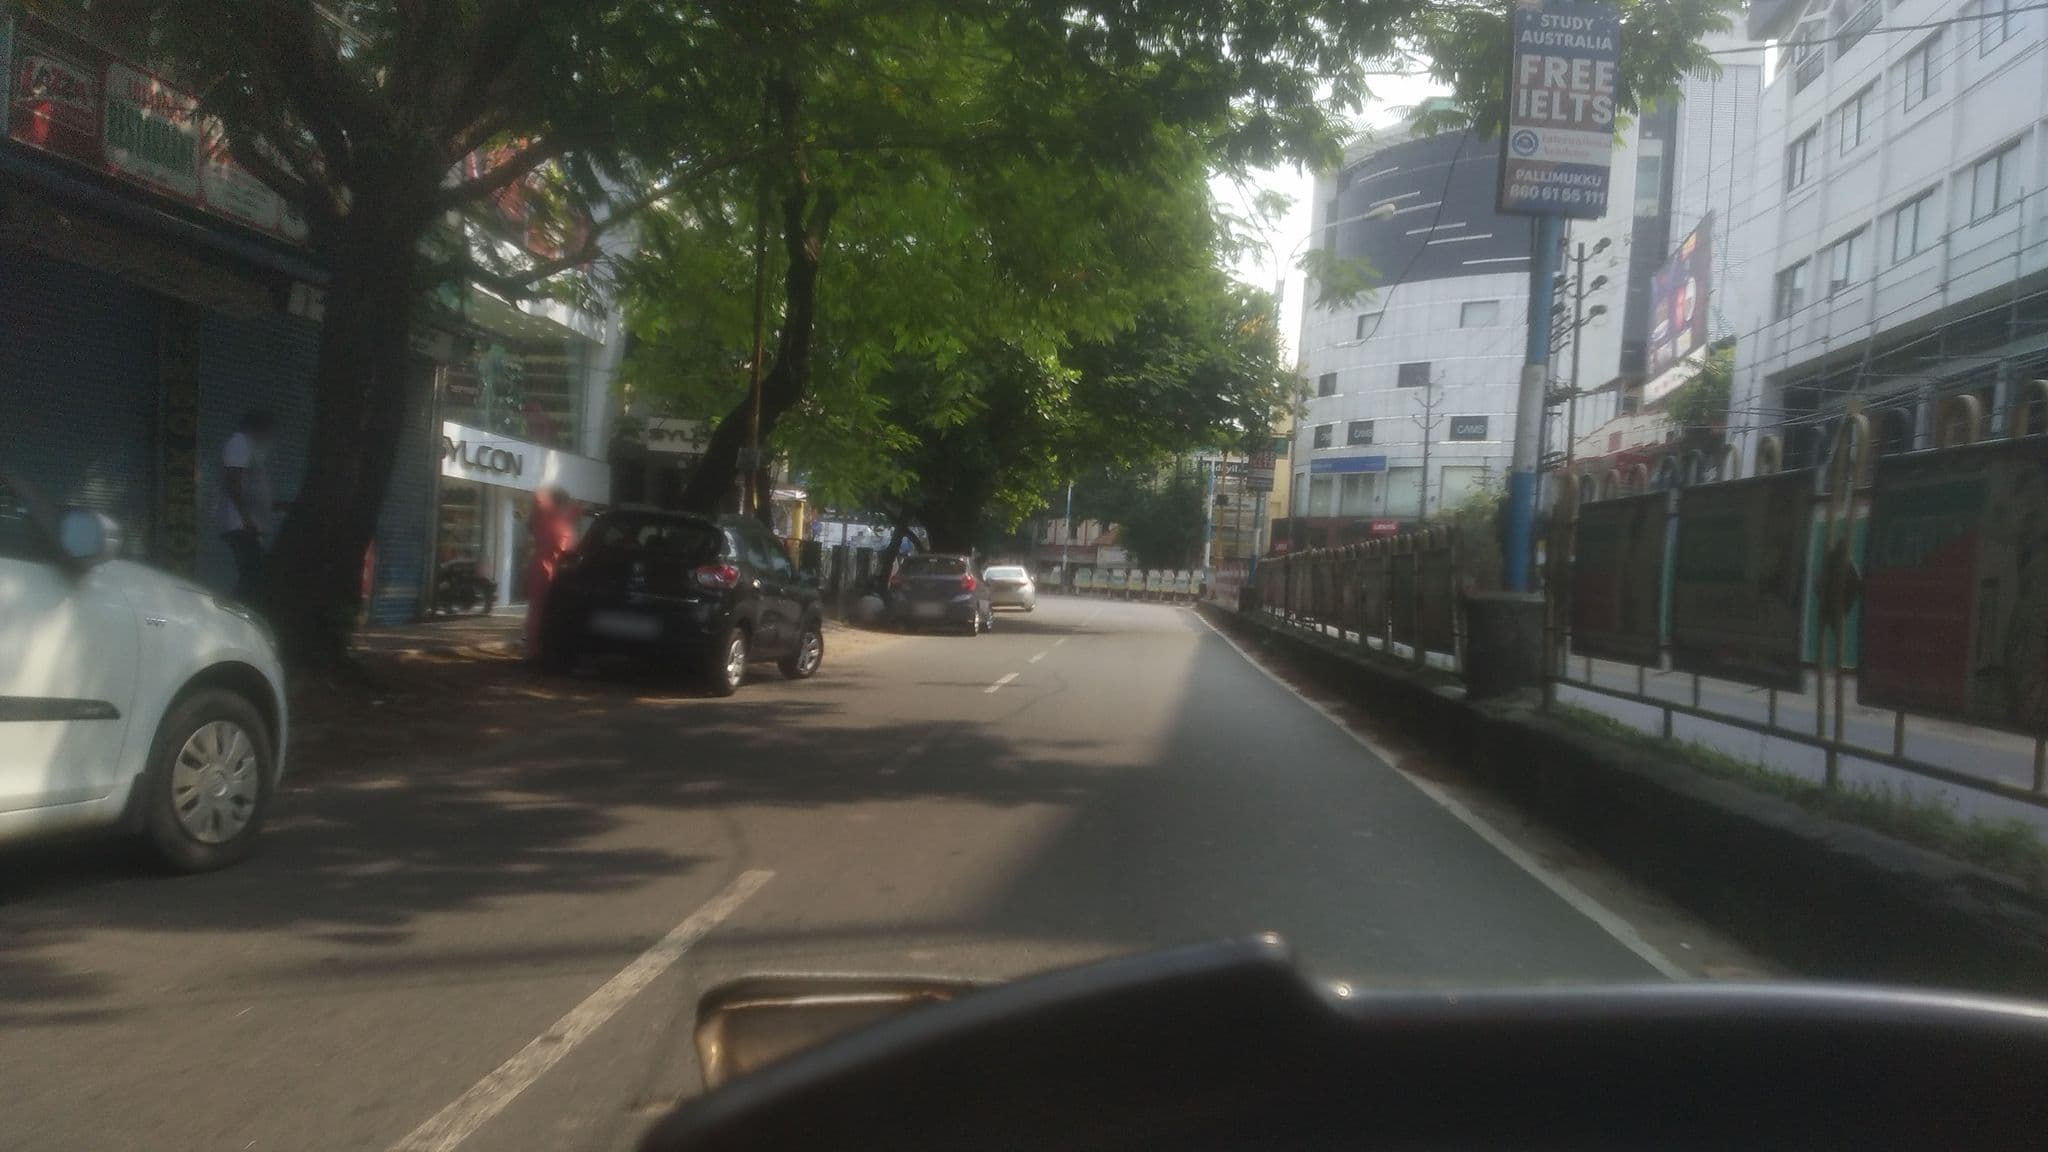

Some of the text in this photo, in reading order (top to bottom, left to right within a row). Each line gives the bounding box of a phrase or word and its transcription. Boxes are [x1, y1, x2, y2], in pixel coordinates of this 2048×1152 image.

[1540, 15, 1595, 30] STUDY
[1521, 31, 1613, 50] AUSTRALIA
[1519, 54, 1615, 93] FREE
[1518, 89, 1613, 124] IELTS
[1515, 168, 1603, 187] PALLIMUKKU
[1456, 424, 1486, 435] CAMS
